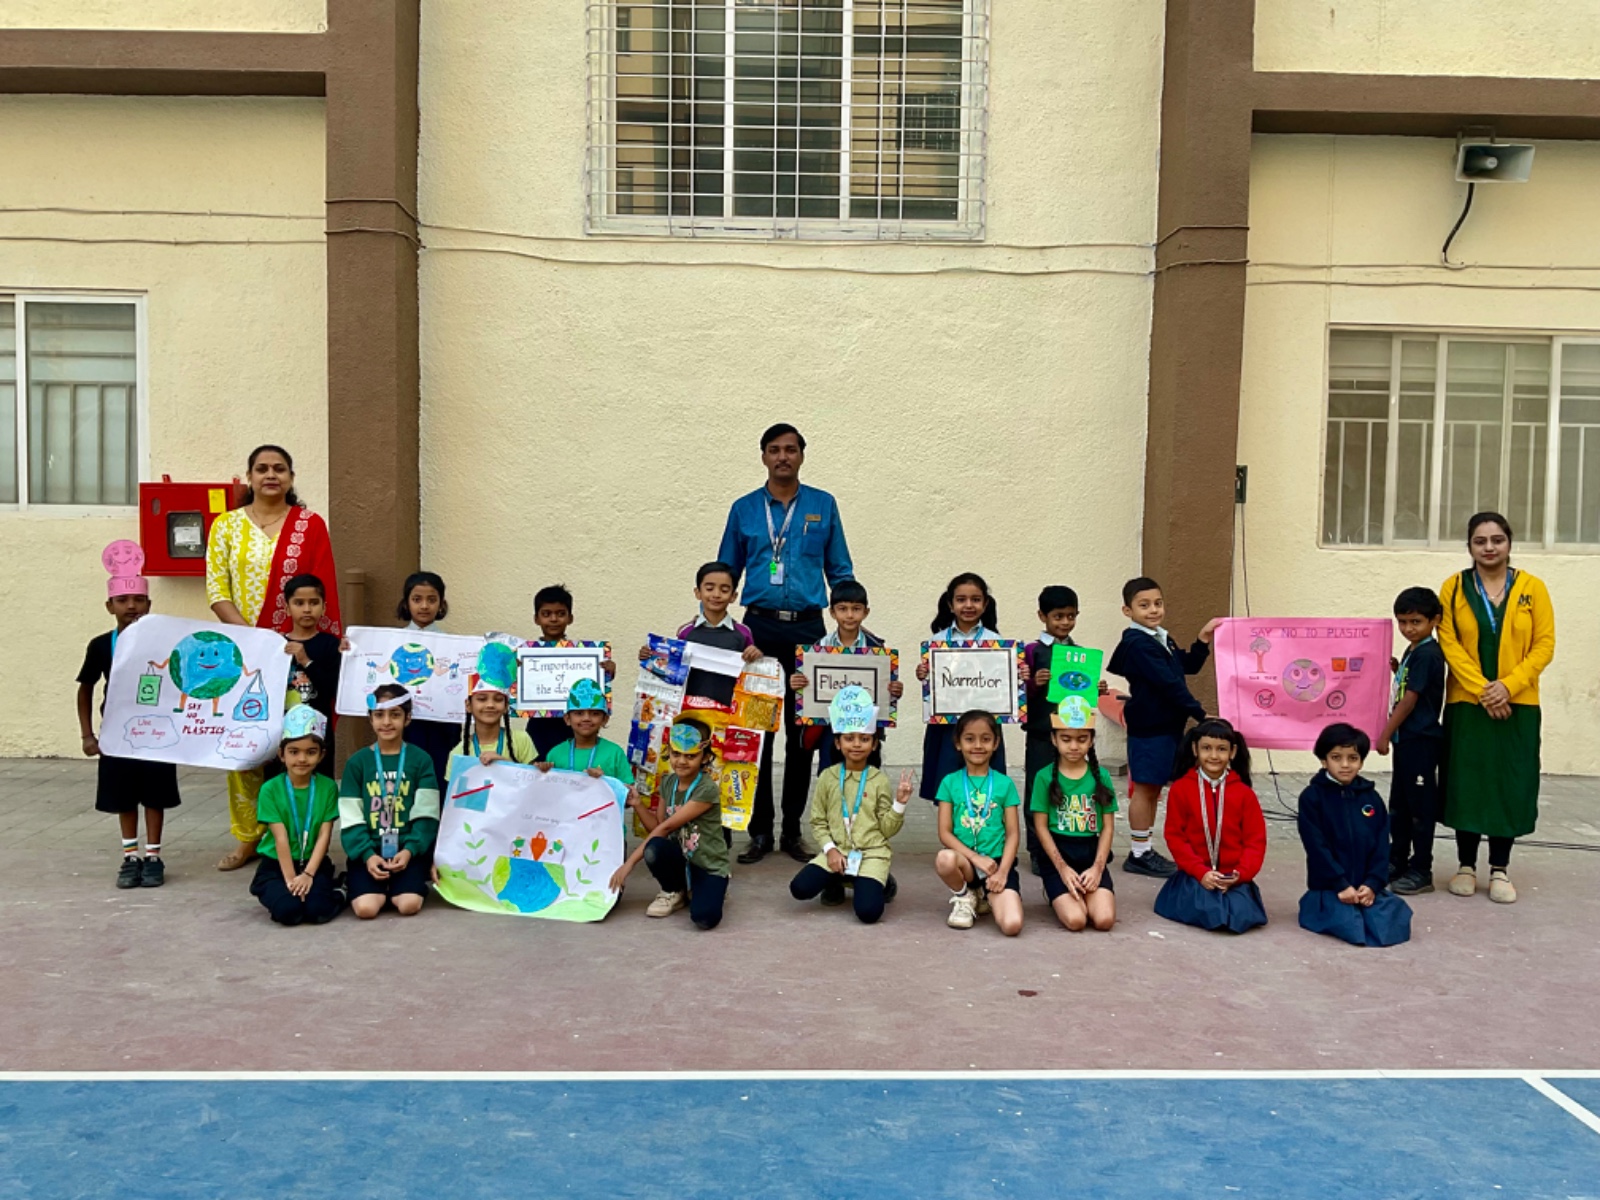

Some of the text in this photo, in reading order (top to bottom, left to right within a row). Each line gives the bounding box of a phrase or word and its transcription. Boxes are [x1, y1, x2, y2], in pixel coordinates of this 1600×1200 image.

[1250, 628, 1370, 638] SAY NO TO PLASTIC
[528, 658, 592, 674] Importance
[555, 671, 565, 684] of
[942, 666, 1002, 688] Narrator
[536, 684, 551, 695] the
[842, 690, 859, 700] SAY
[187, 702, 203, 711] SAY
[182, 724, 226, 735] PLASTICS
